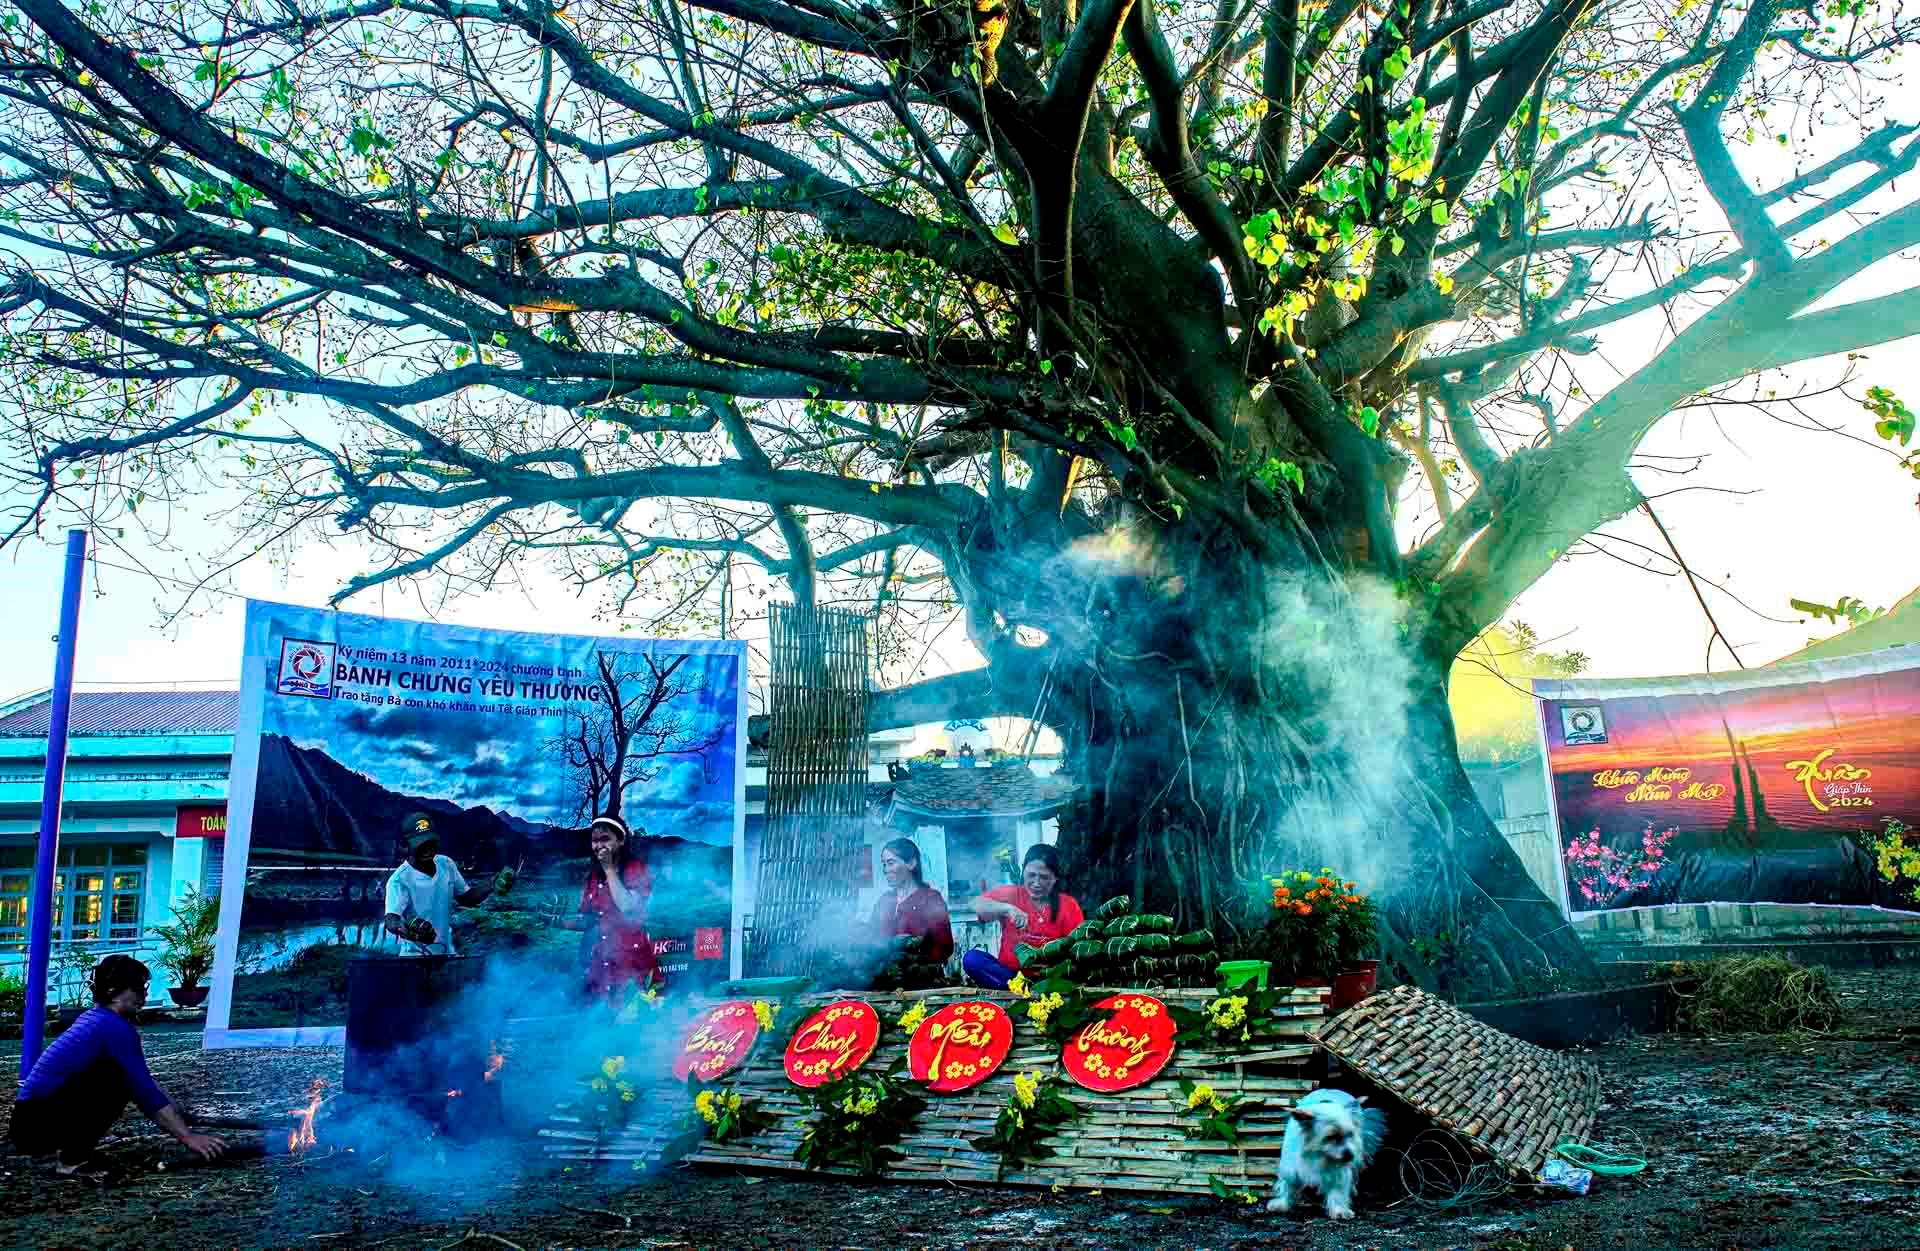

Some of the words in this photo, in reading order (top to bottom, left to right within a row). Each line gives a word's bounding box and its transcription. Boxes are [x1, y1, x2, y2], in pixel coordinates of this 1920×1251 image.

[356, 648, 388, 662] niệm
[391, 652, 409, 664] 13
[411, 654, 437, 667] năm
[511, 664, 554, 678] chương
[336, 661, 391, 687] BÁNH
[399, 670, 472, 694] CHƯNG
[478, 676, 514, 697] YÊU
[519, 681, 600, 702] THƯƠNG
[334, 686, 358, 701] Trao
[361, 691, 384, 706] tặng
[405, 697, 424, 706] con
[427, 698, 446, 712] khó
[479, 704, 495, 713] vui
[499, 703, 513, 715] Tết
[515, 705, 537, 717] Giáp
[1592, 769, 1641, 789] Chúc
[1643, 766, 1692, 784] Mừng
[1625, 782, 1673, 803] Năm
[1678, 782, 1726, 800] Mới
[1784, 748, 1872, 812] Xuân
[1823, 782, 1850, 799] Giáp
[1829, 797, 1873, 807] 2024
[686, 1024, 744, 1053] Bánh
[794, 1021, 858, 1071] Chưng
[930, 1018, 991, 1081] Yêu
